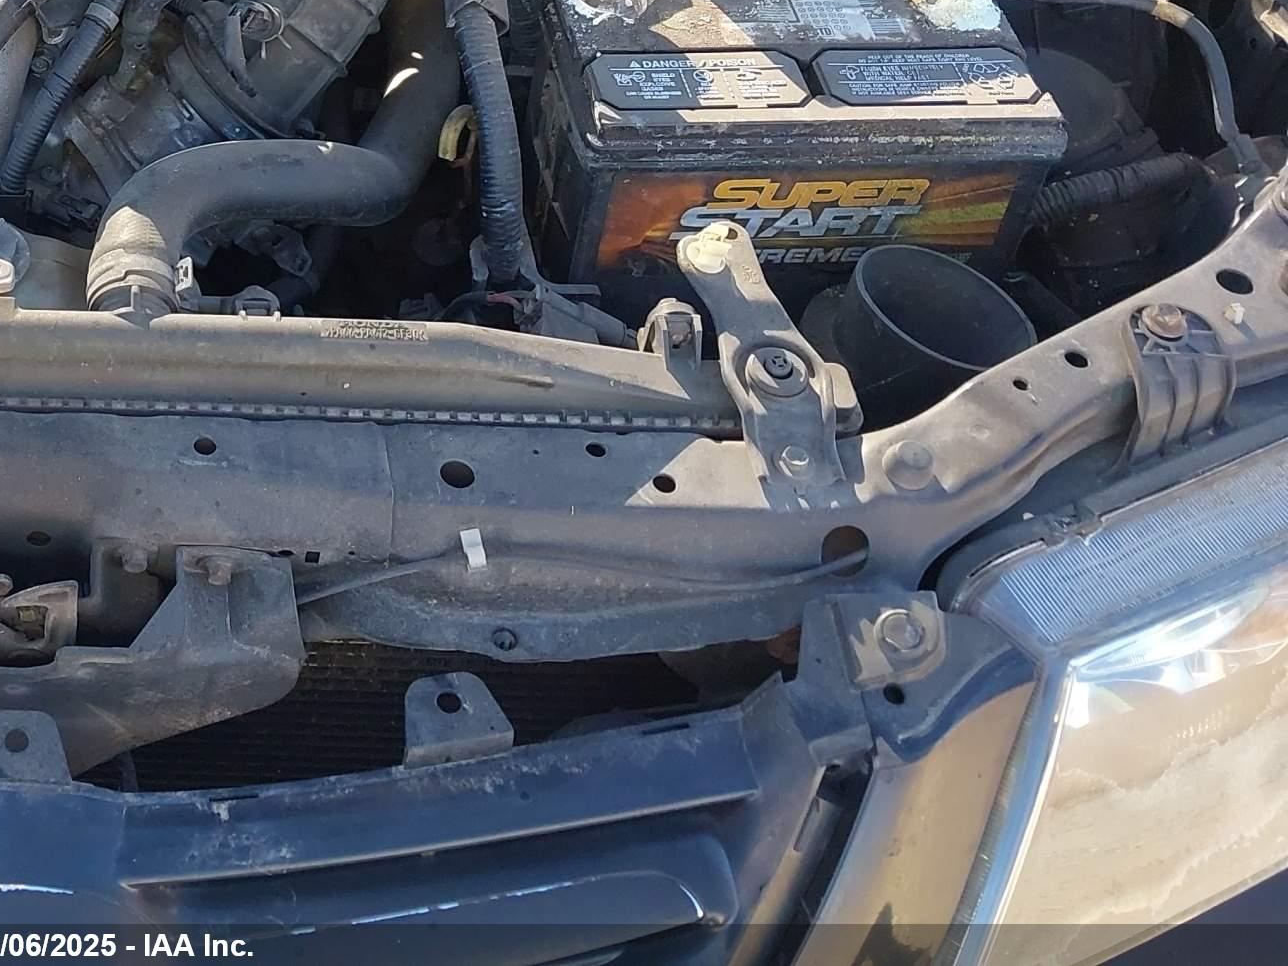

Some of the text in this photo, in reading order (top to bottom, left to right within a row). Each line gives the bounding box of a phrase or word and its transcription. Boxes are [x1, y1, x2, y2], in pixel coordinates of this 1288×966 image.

[643, 60, 694, 68] DANGER
[710, 58, 756, 66] POISON
[707, 179, 930, 209] SUPER
[669, 205, 923, 240] START
[756, 247, 866, 263] REME
